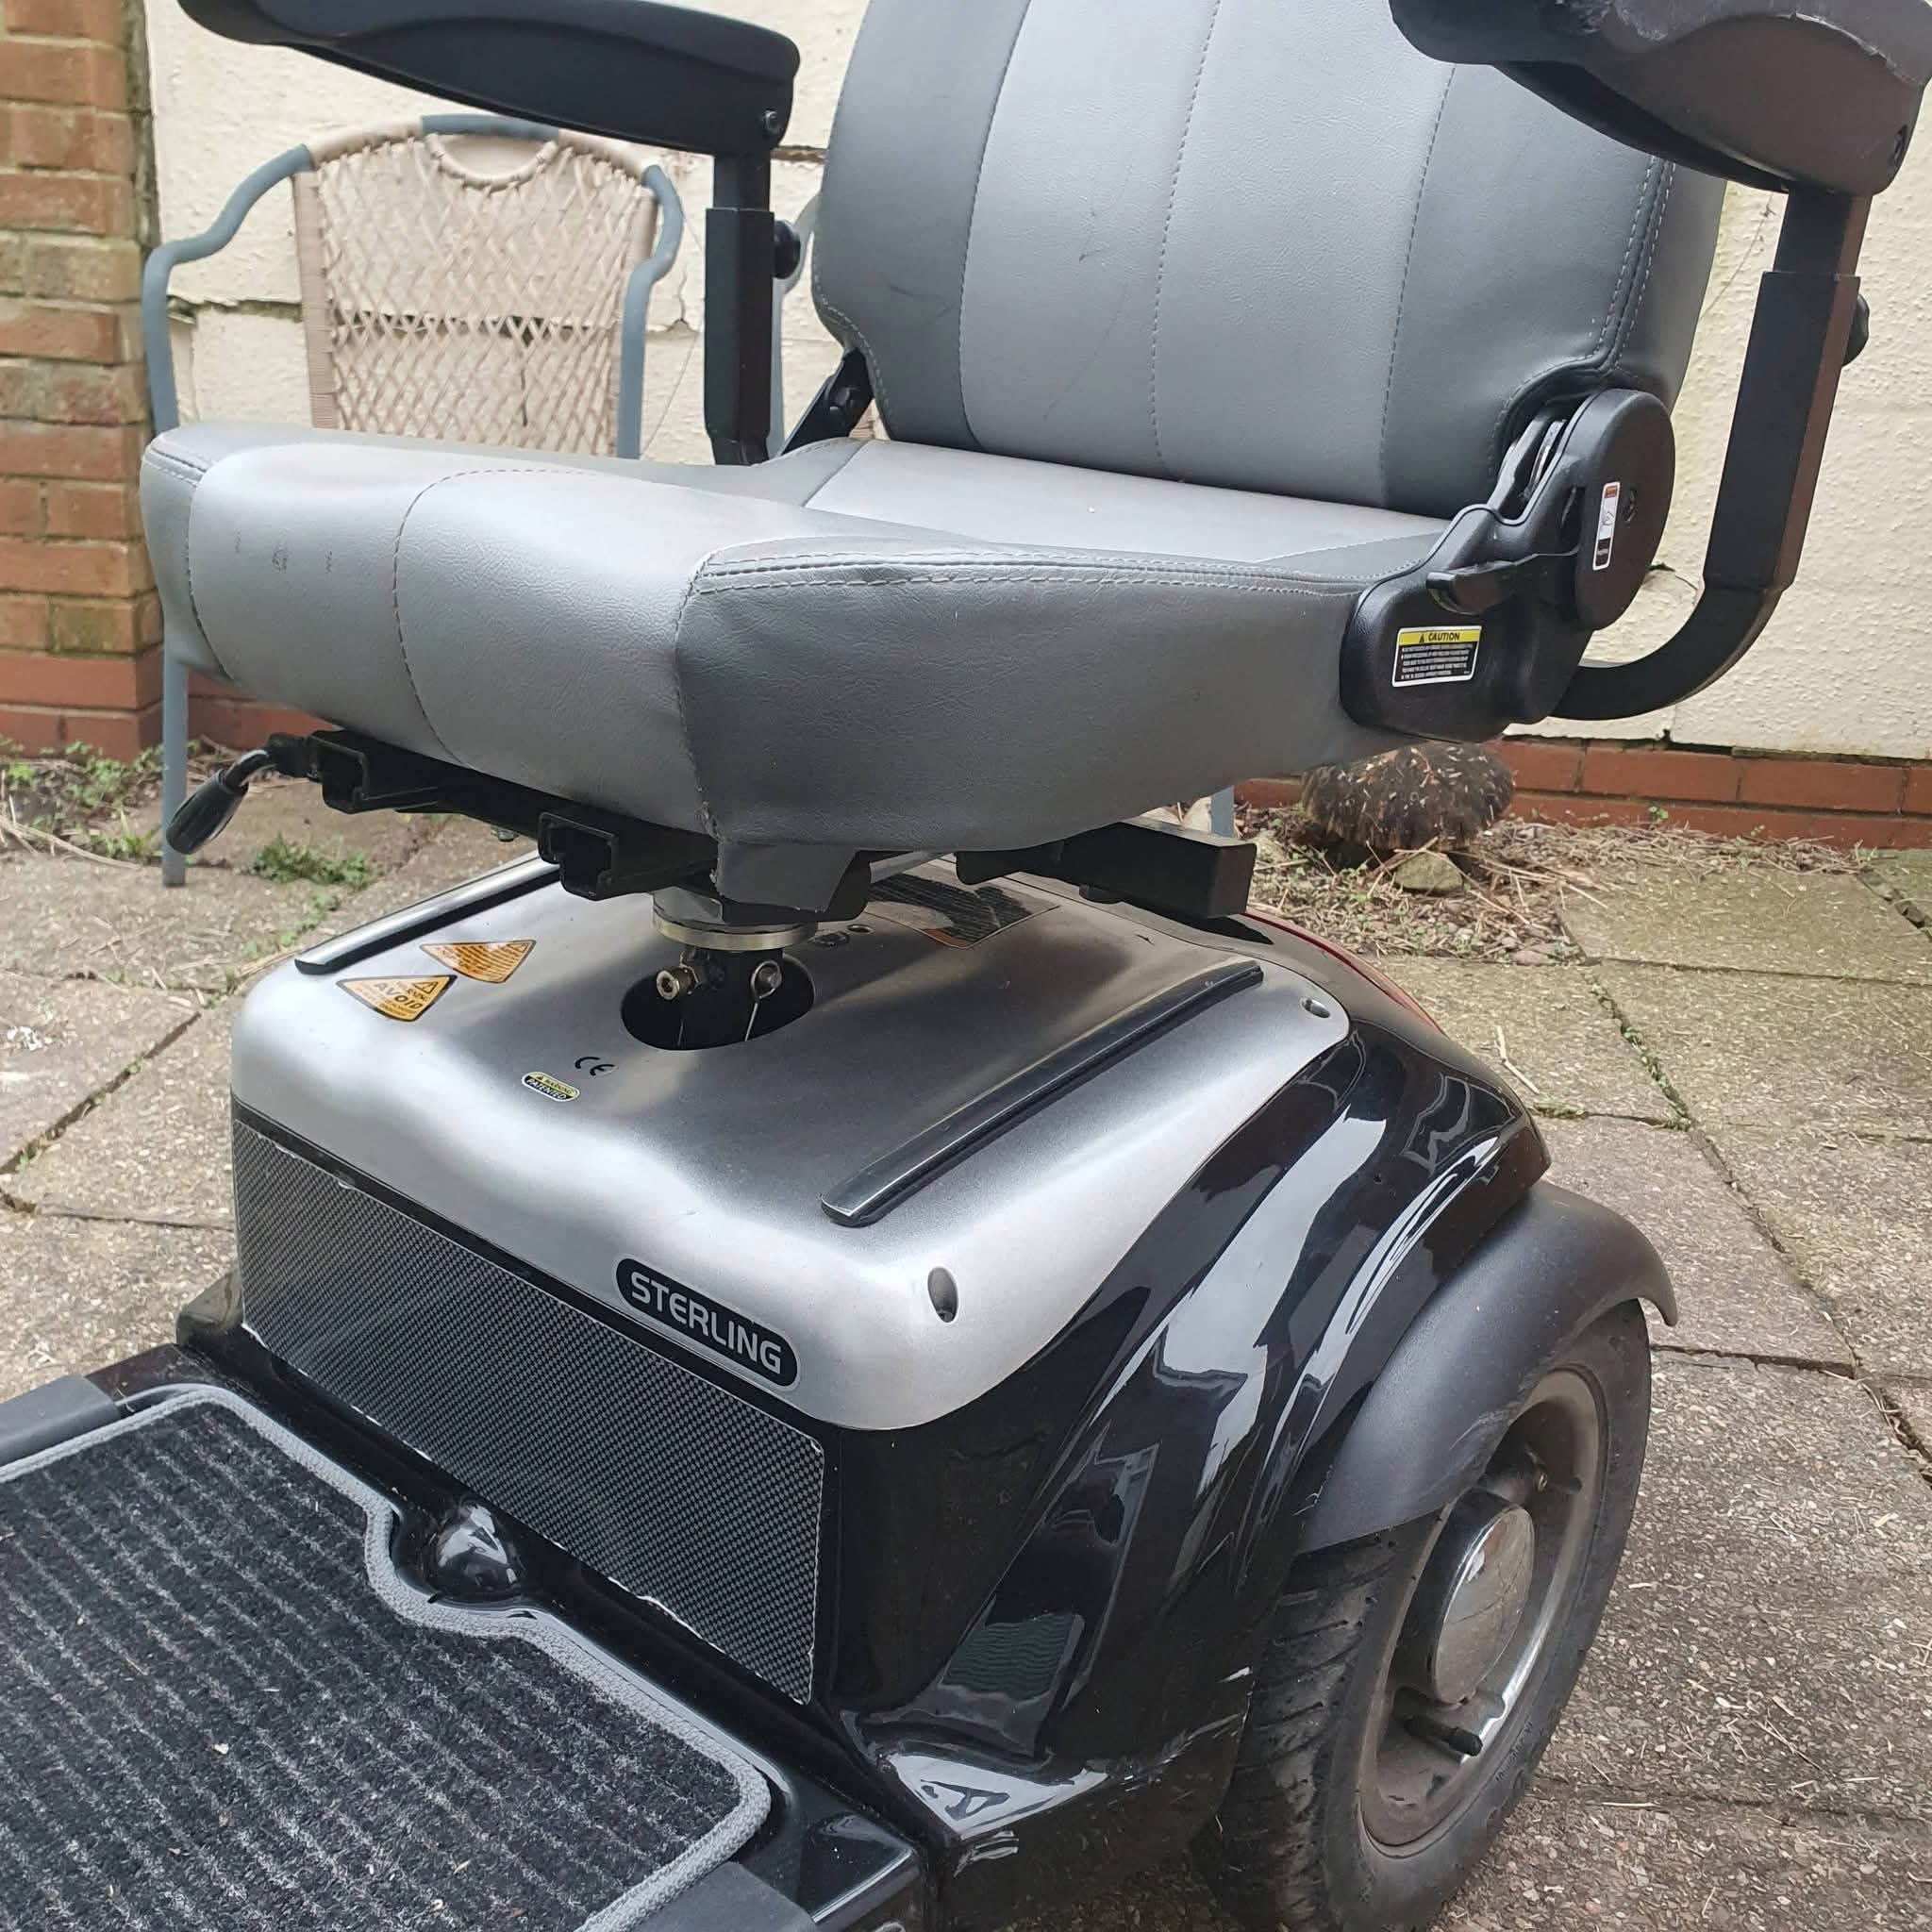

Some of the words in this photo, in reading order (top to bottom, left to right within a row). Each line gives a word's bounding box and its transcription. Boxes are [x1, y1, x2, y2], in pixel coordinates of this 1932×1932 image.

[1427, 632, 1461, 641] CAUTION
[375, 982, 424, 1009] AVOID
[630, 1271, 782, 1374] STERLING
